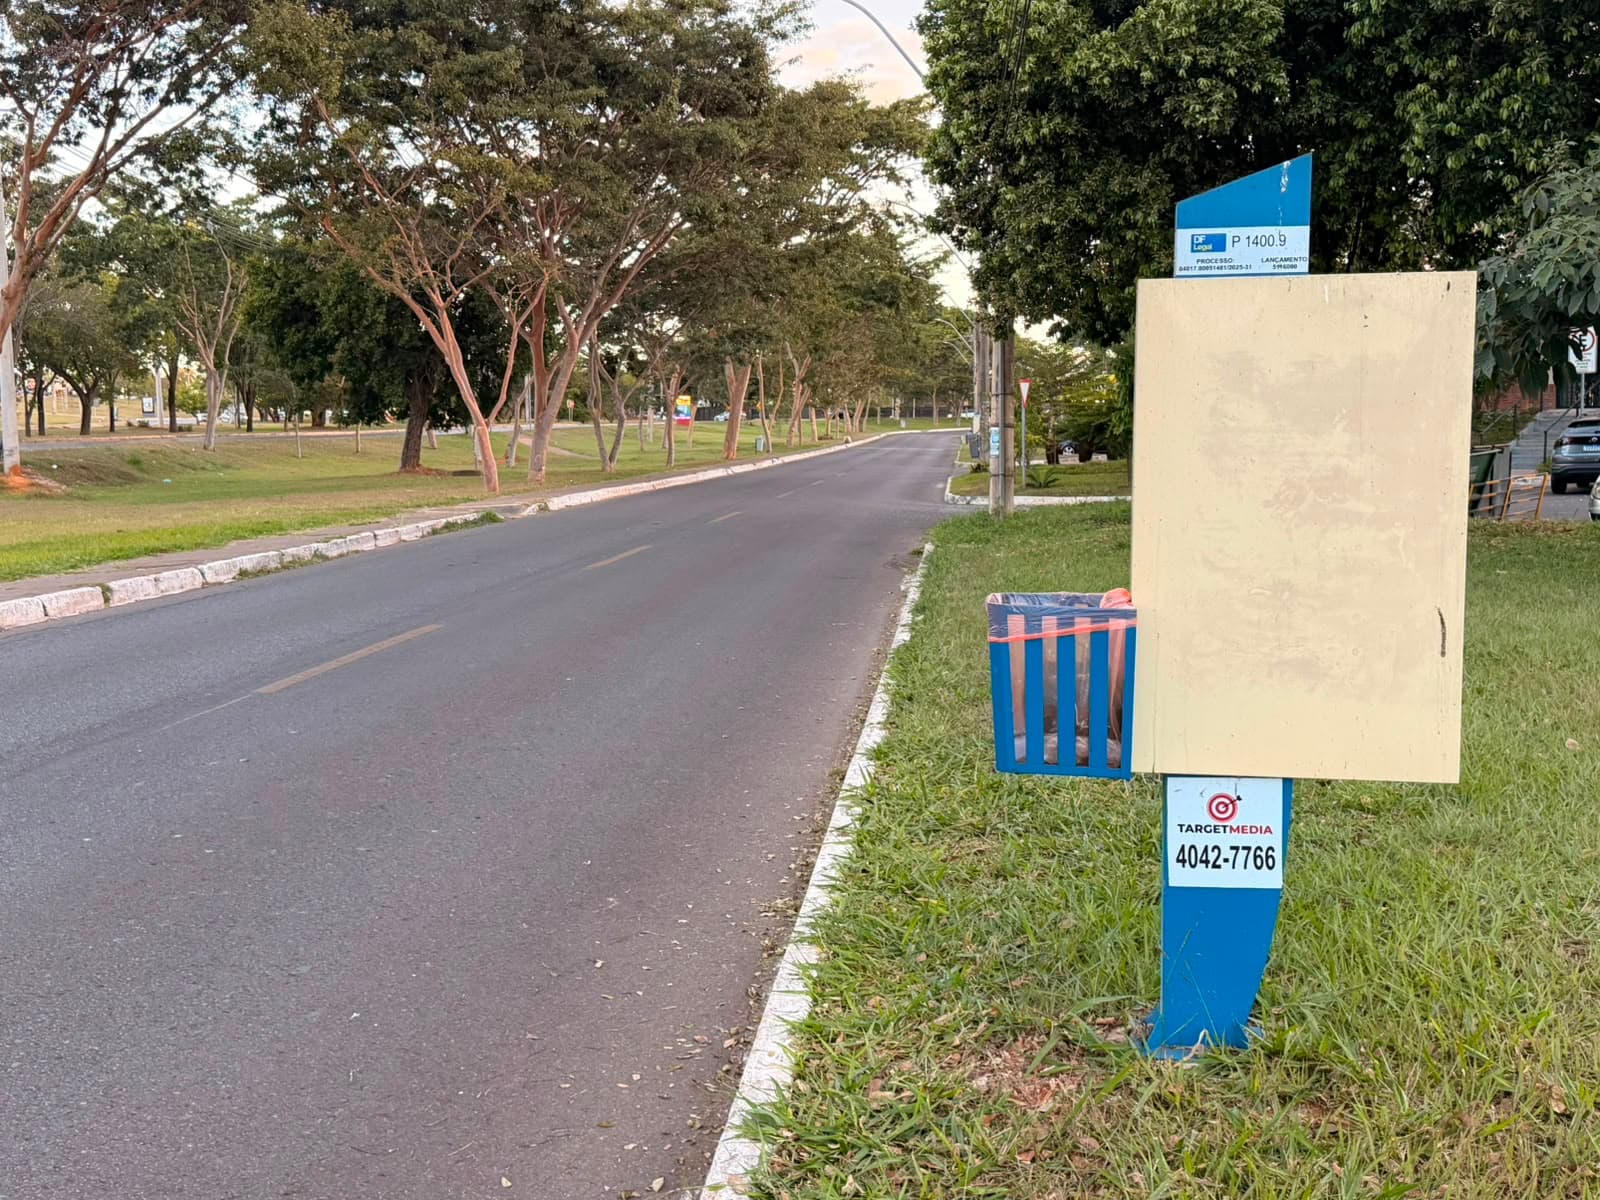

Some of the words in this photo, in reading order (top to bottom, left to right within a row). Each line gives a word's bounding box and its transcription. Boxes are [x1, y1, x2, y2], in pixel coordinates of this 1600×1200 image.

[1194, 235, 1207, 244] DF
[1232, 235, 1241, 248] P
[1245, 234, 1287, 248] 1400.9
[1193, 243, 1213, 252] Legal
[1196, 257, 1233, 265] PROCESSO
[1261, 256, 1308, 264] LANÇAMENTO
[1175, 843, 1276, 871] 4042-7766
